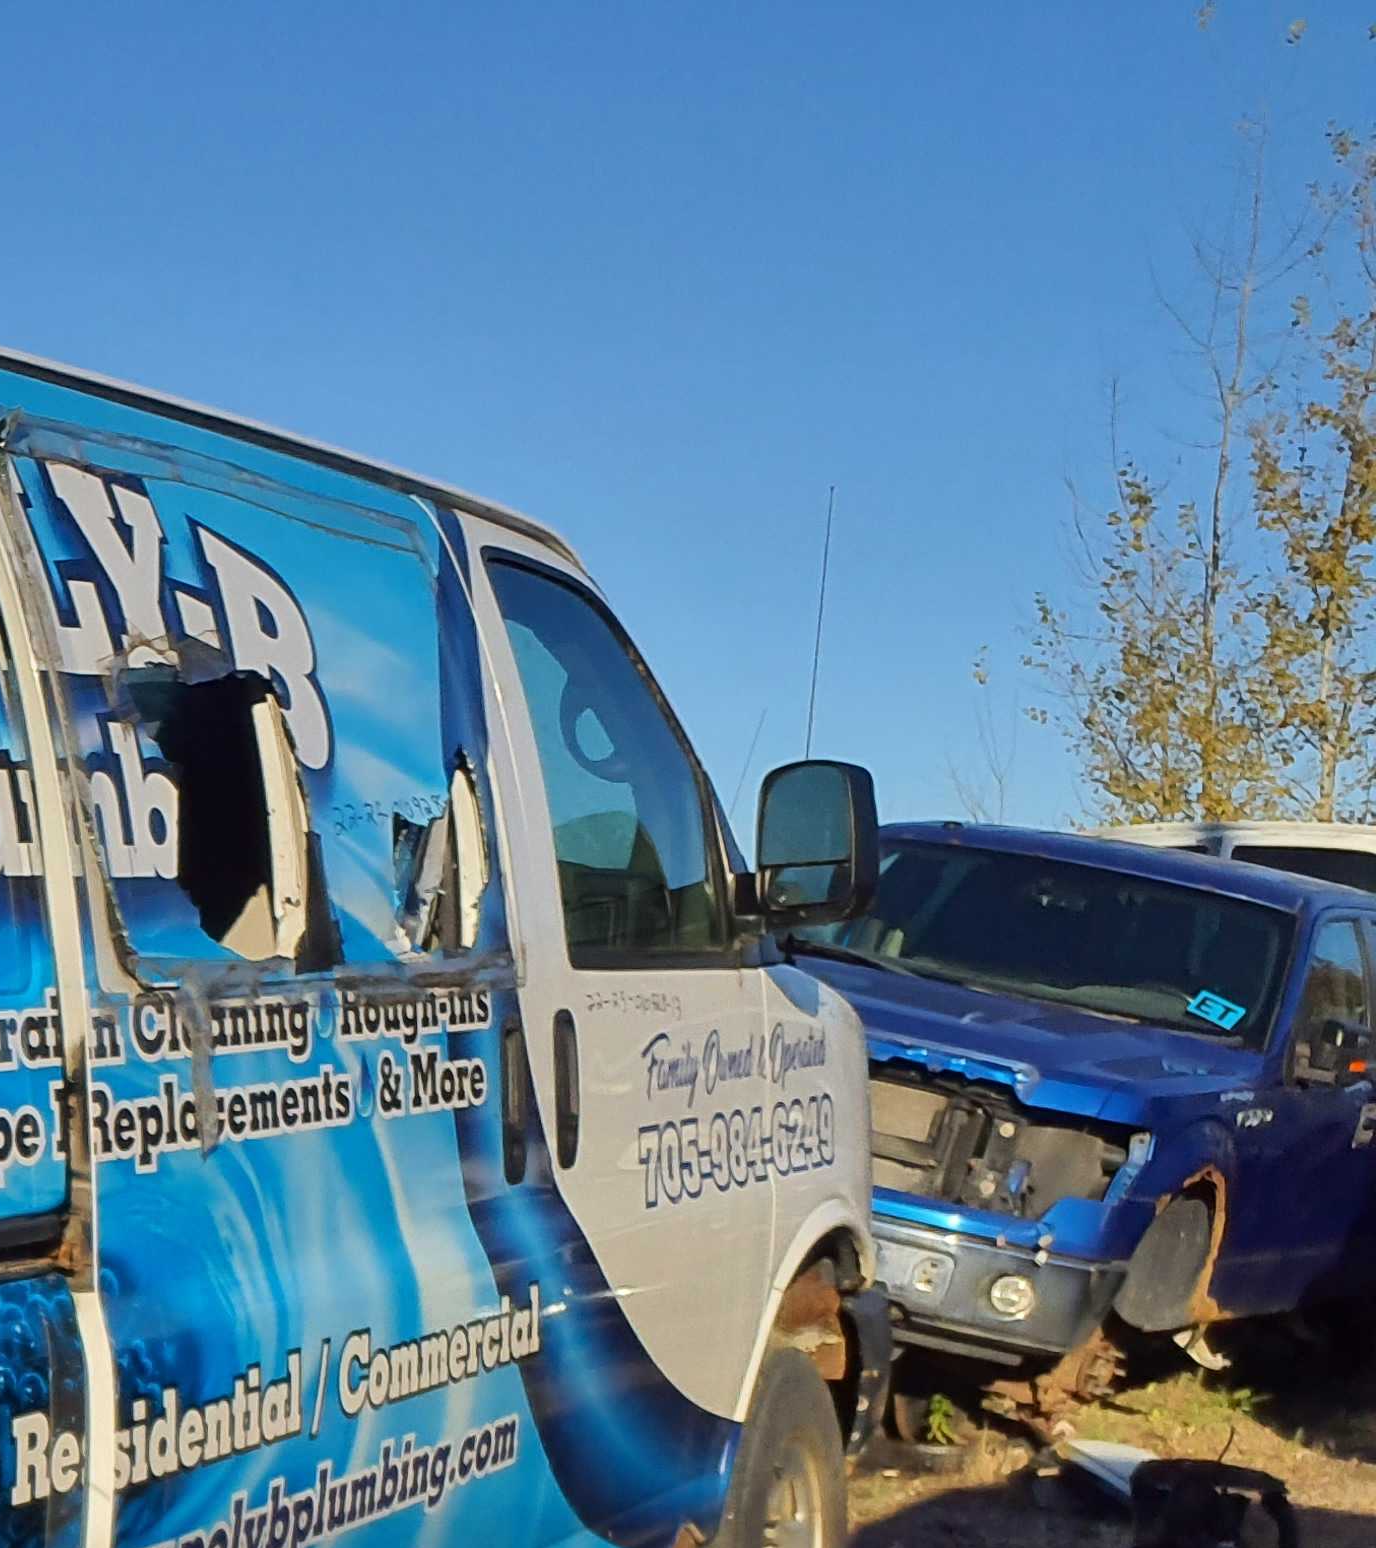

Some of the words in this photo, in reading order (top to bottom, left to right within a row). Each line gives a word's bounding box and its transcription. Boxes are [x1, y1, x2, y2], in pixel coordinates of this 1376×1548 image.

[378, 1056, 402, 1109] &
[411, 1054, 485, 1109] More
[637, 1092, 835, 1210] 705-984-6249
[11, 1353, 302, 1506] Residential
[338, 1286, 541, 1415] Commercial
